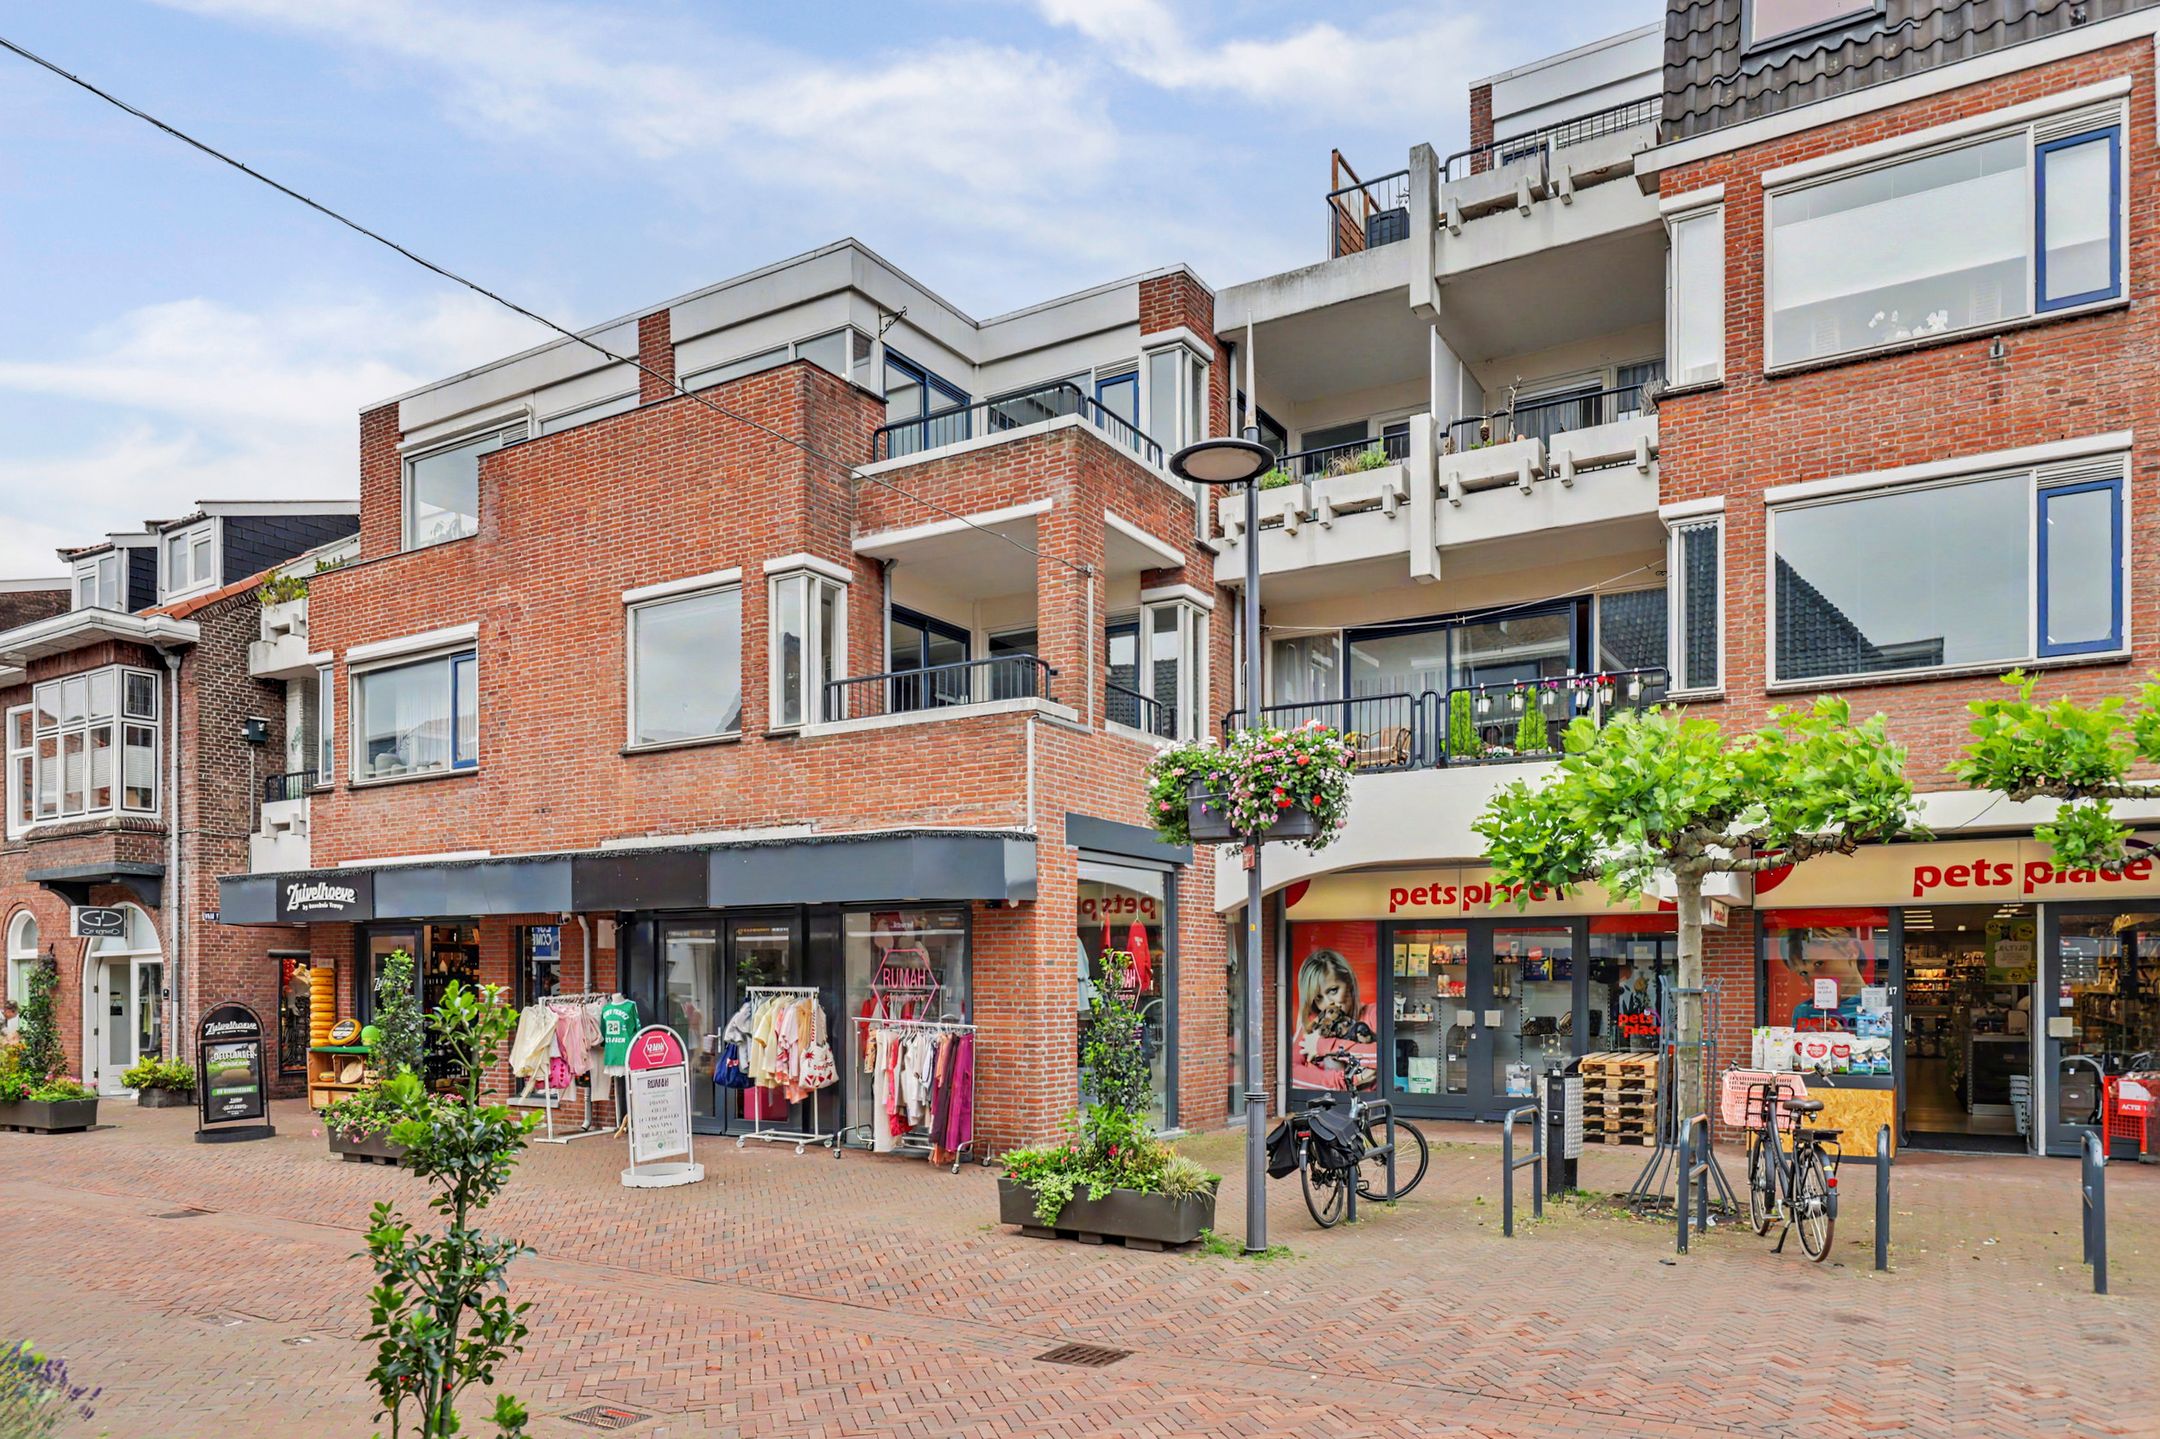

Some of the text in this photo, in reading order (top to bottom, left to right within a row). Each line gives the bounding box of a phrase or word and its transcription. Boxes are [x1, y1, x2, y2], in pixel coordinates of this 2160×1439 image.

[1913, 859, 2013, 897] pets
[286, 882, 357, 911] Zuivelhoeve
[1389, 882, 1457, 913] pets
[883, 967, 926, 989] RUMAH
[1888, 986, 1898, 996] 17
[1618, 1012, 1654, 1028] pets
[1796, 1017, 1839, 1033] pets
